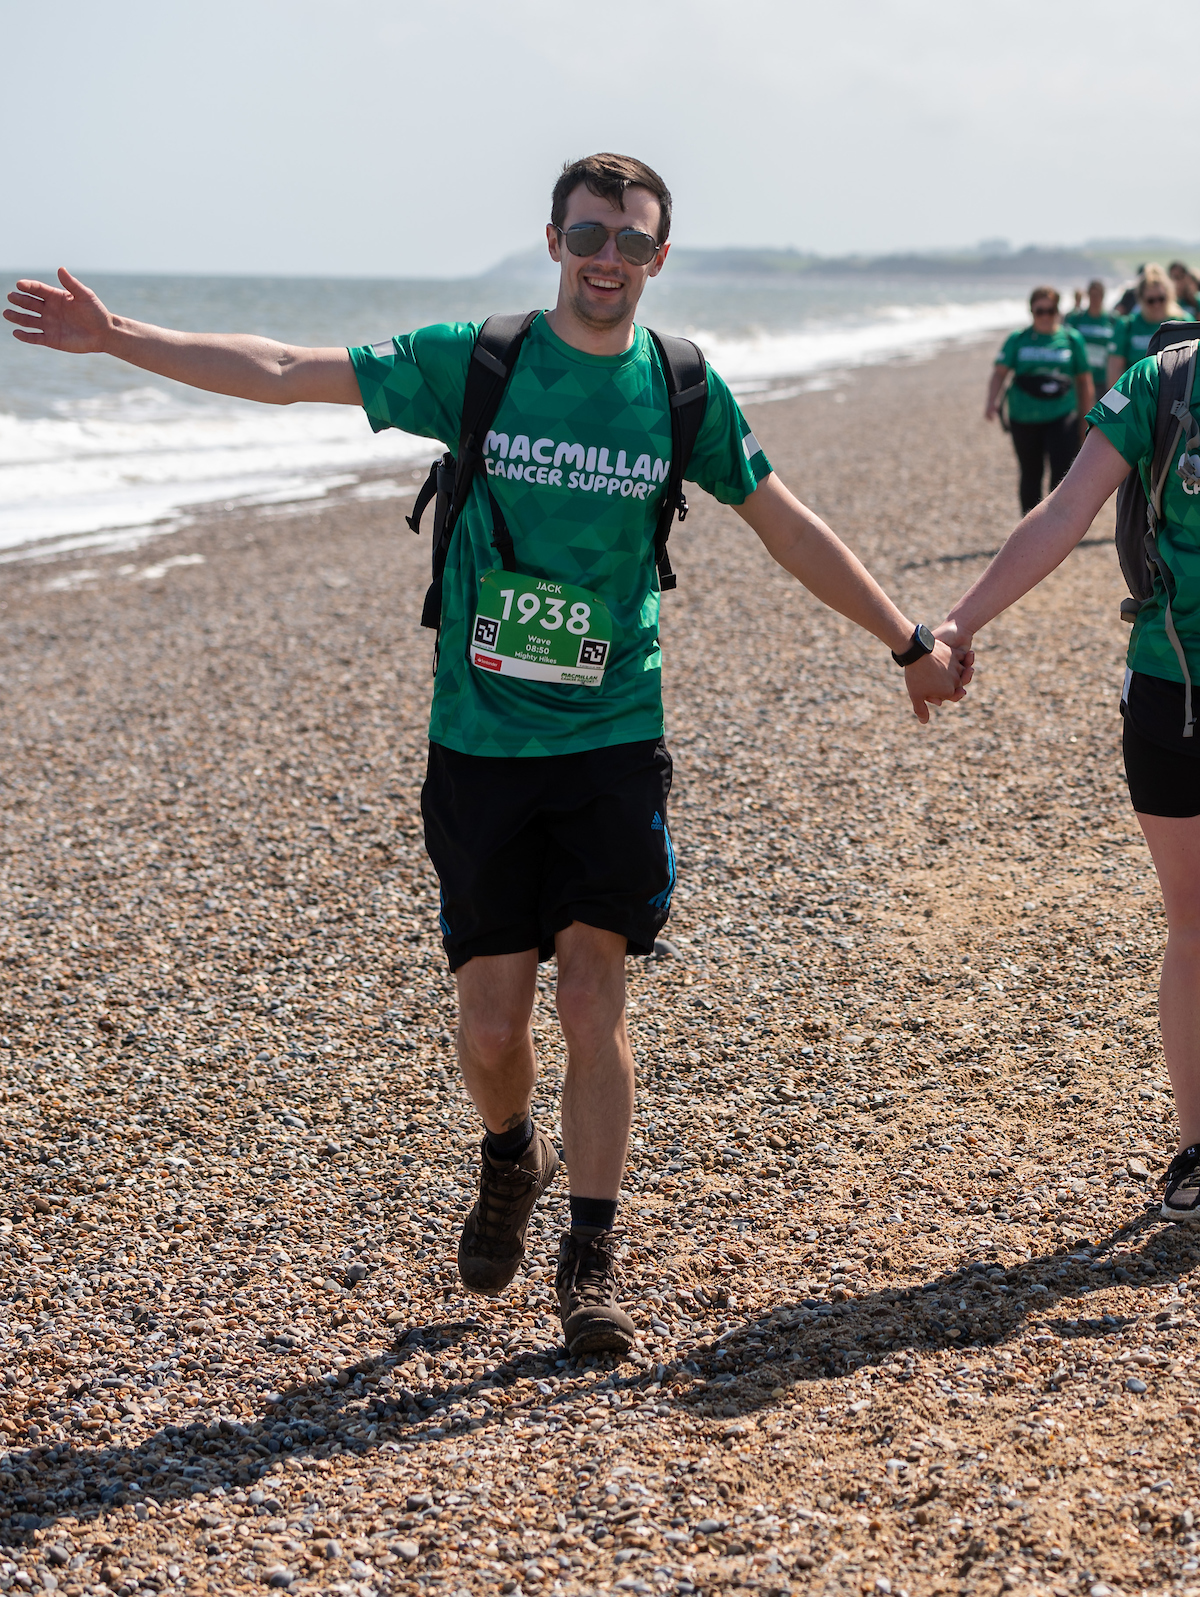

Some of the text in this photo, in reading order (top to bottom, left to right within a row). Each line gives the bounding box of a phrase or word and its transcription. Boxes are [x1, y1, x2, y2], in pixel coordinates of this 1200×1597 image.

[482, 430, 670, 483] MACMILLAN
[484, 458, 656, 500] CANCER SUPPORT
[536, 581, 562, 594] JACK
[500, 589, 591, 635] 1938
[527, 634, 552, 646] Wave
[525, 644, 550, 655] 08:50
[514, 651, 557, 664] Mighty Hikes
[561, 672, 598, 680] MACMILLAN
